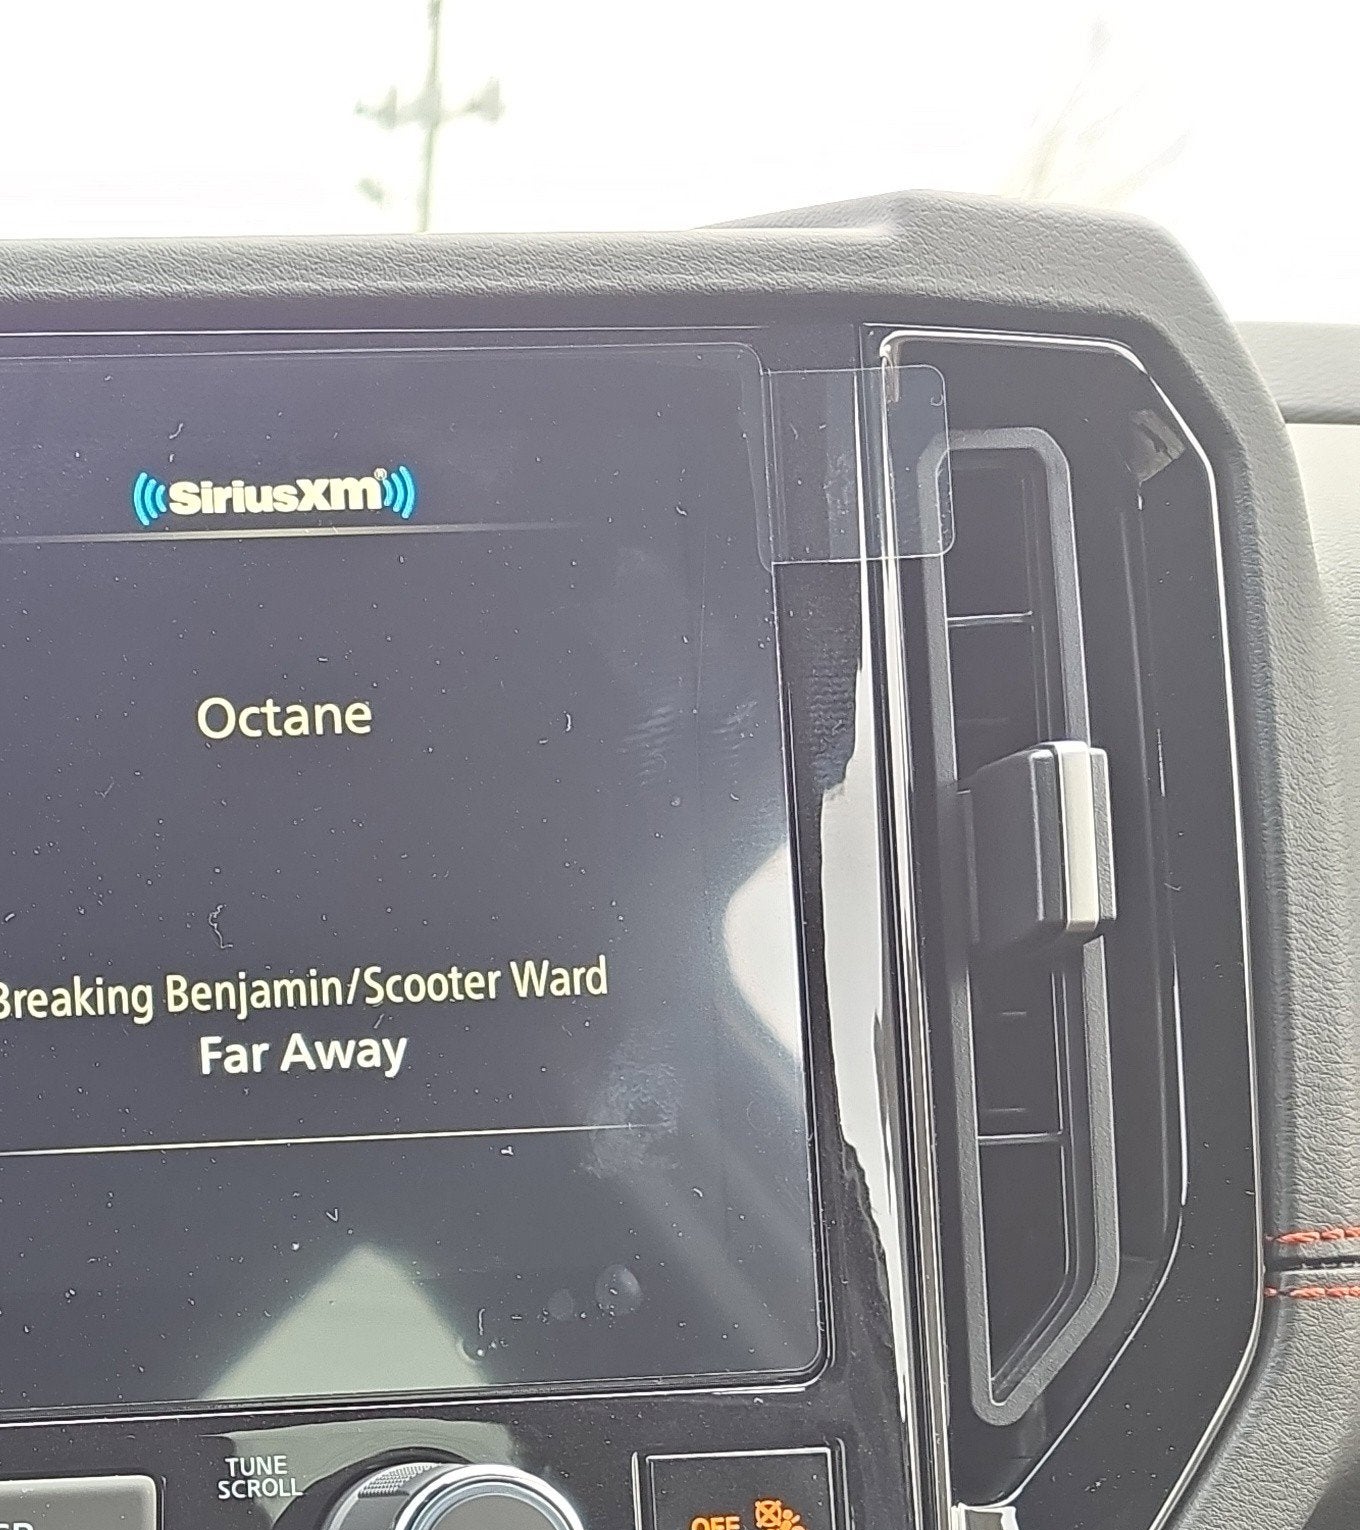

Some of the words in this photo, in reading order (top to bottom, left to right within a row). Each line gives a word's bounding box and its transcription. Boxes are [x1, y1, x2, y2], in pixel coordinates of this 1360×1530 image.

[197, 698, 372, 739] Octane
[167, 963, 501, 1020] Benjamin/Scooter
[510, 955, 608, 997] Ward
[199, 1036, 268, 1075] Far
[281, 1032, 408, 1077] Away
[217, 1474, 303, 1500] SCROLL
[225, 1456, 287, 1477] TUNE
